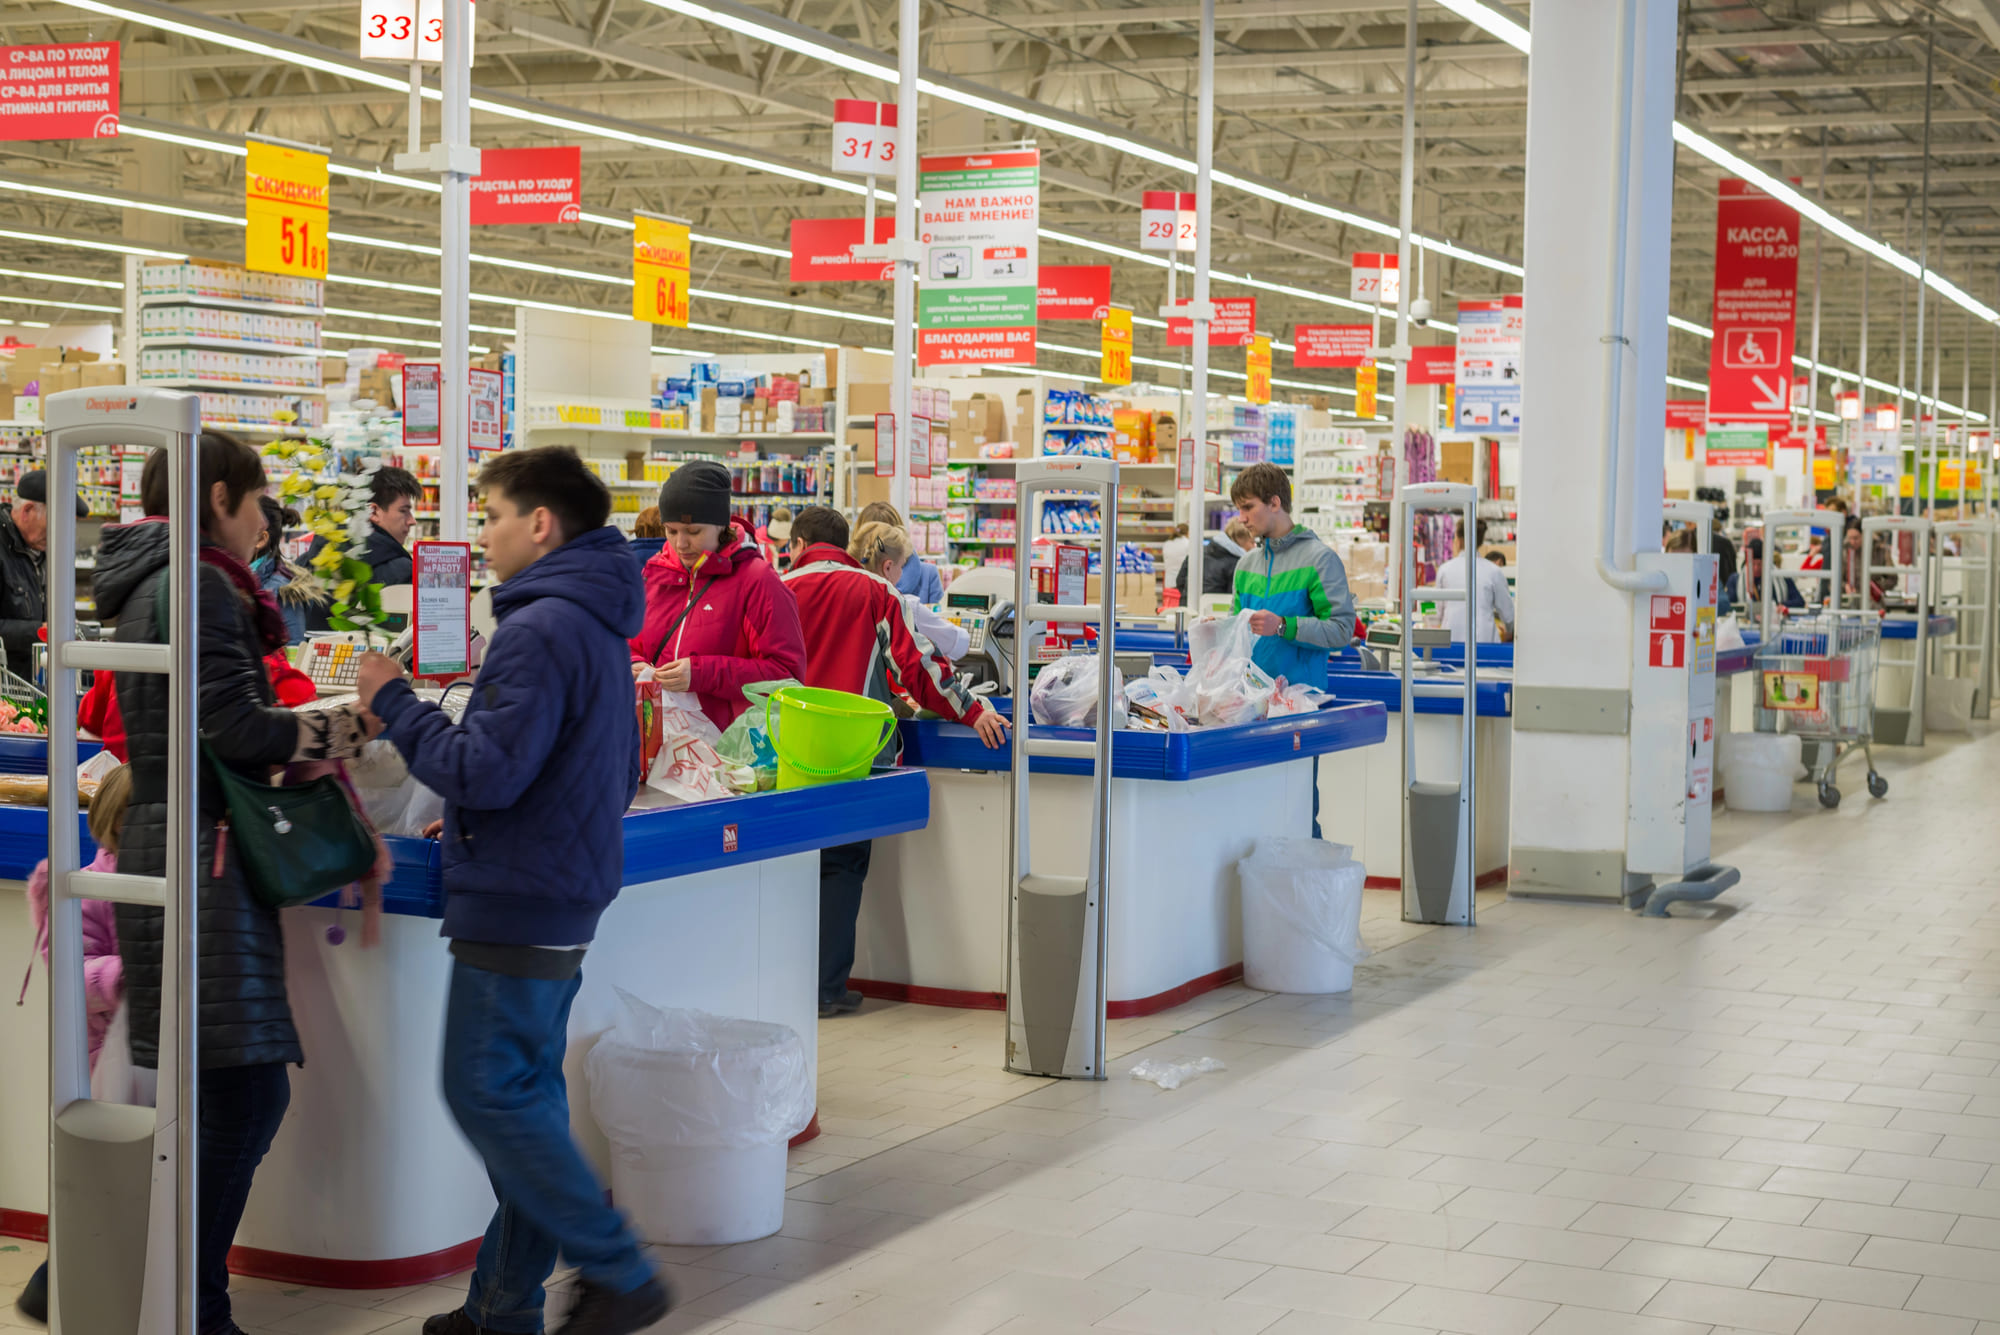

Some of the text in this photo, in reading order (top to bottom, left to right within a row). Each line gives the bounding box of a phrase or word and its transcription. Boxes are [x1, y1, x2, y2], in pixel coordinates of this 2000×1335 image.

[367, 14, 411, 40] 33
[424, 18, 443, 42] 3
[9, 47, 110, 63] СР-ВА ПО УХОДУ
[9, 67, 55, 81] ЛИЦОМ
[57, 66, 66, 78] И
[69, 64, 110, 78] ТЕЛОМ
[1, 82, 110, 98] СР-ВА ДЛЯ БРИТЬЯ
[0, 99, 110, 115] НТИМНАЯ ГИГИЕНА
[100, 122, 116, 135] 42
[842, 137, 873, 159] 31
[254, 175, 323, 203] СКИДКИ!
[518, 180, 534, 190] ПО
[536, 178, 573, 190] УХОДУ
[497, 192, 573, 204] ЗА ВОЛОСАМИ
[945, 195, 1034, 209] НАМ ВАЖНО
[924, 208, 1034, 224] ВАШЕ МНЕНИЕ!
[1148, 222, 1174, 238] 29
[1727, 227, 1788, 243] КАССА
[281, 216, 308, 268] 51
[1006, 263, 1014, 274] 1
[1357, 278, 1379, 292] 27
[656, 277, 676, 320] 64
[924, 332, 1031, 345] БЛАГОДАРИМ ВАС
[940, 348, 1014, 360] ЗА УЧАСТИЕ!
